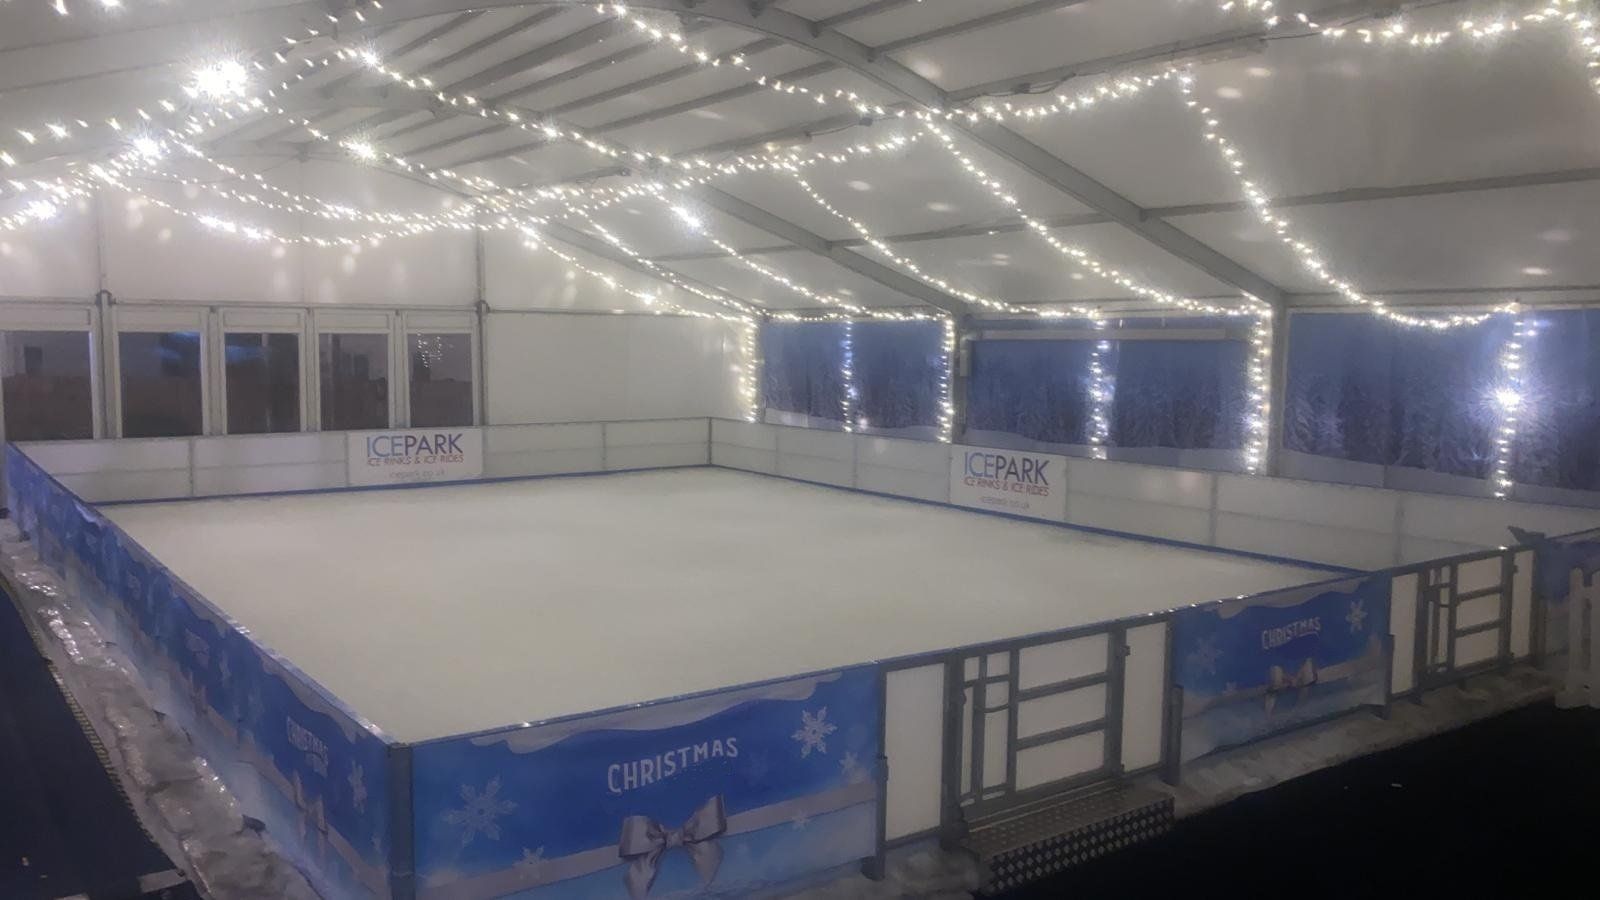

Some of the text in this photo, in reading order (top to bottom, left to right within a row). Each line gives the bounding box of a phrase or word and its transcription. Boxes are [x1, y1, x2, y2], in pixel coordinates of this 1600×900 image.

[366, 433, 463, 457] ICEPARK
[367, 454, 464, 467] ICE RINKS & ICE RIDES
[964, 452, 1050, 486] ICEPARK
[964, 477, 976, 487] ICE
[977, 478, 1001, 490] RINKS
[1011, 483, 1024, 493] ICE
[1026, 484, 1050, 497] RIDES
[1262, 616, 1321, 650] CHRISTMAS
[607, 737, 739, 793] CHRISTMAS
